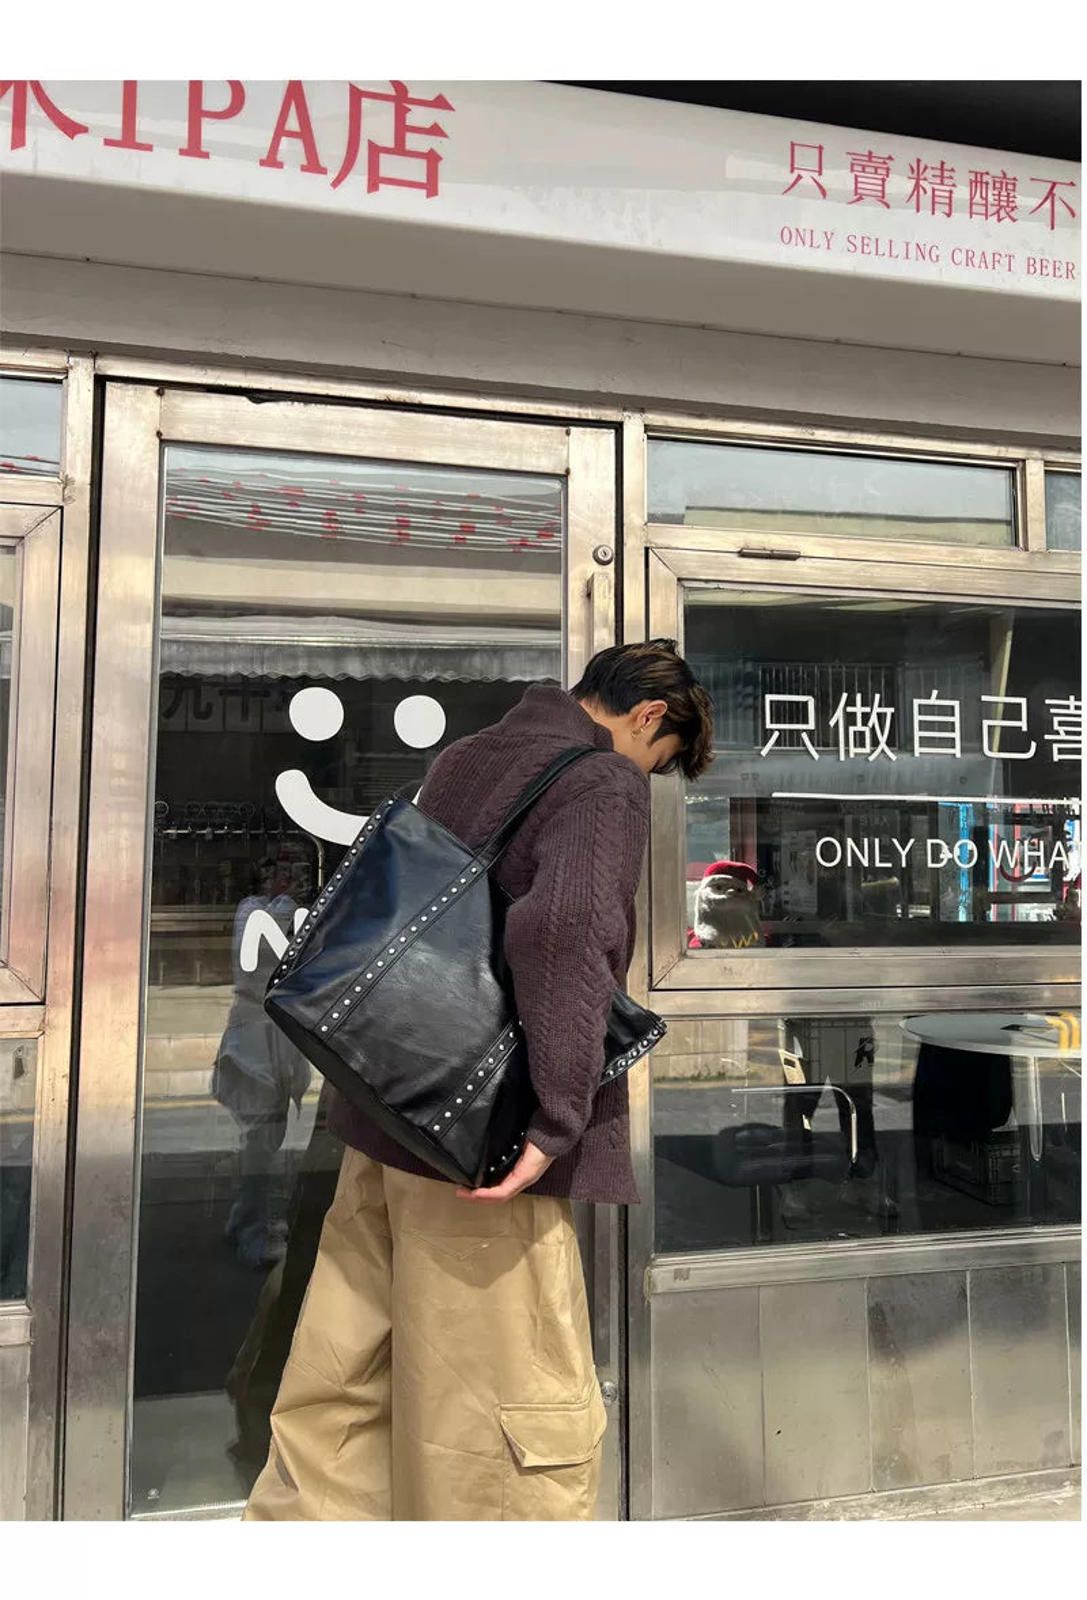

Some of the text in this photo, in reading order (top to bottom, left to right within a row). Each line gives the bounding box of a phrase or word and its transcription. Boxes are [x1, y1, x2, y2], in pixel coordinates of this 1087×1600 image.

[782, 141, 1078, 231] 只賣精釀不
[780, 226, 1076, 280] ONLY SELLING CRAFT BEER
[815, 837, 915, 868] ONLY
[926, 839, 978, 869] DO
